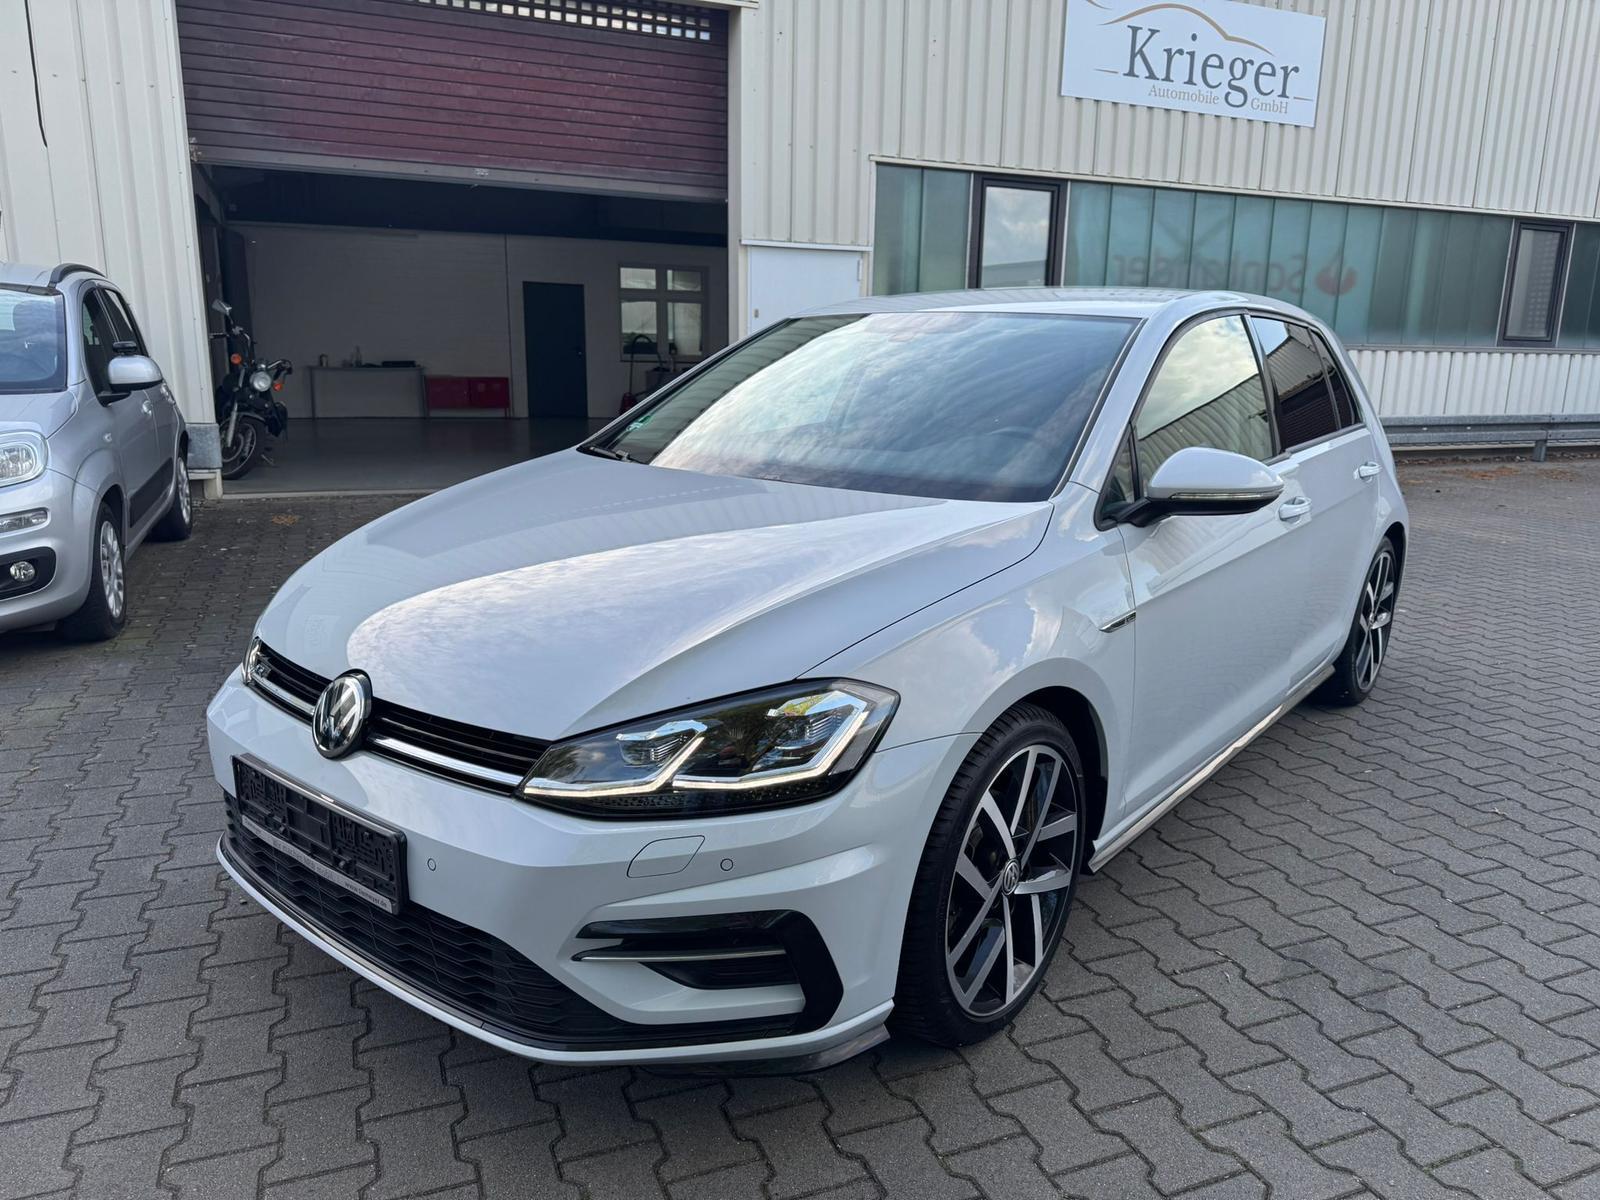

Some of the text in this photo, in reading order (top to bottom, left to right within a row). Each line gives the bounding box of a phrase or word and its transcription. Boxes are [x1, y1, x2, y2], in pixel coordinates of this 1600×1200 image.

[1123, 25, 1300, 108] Krieger
[1148, 84, 1289, 114] Automobile GmbH
